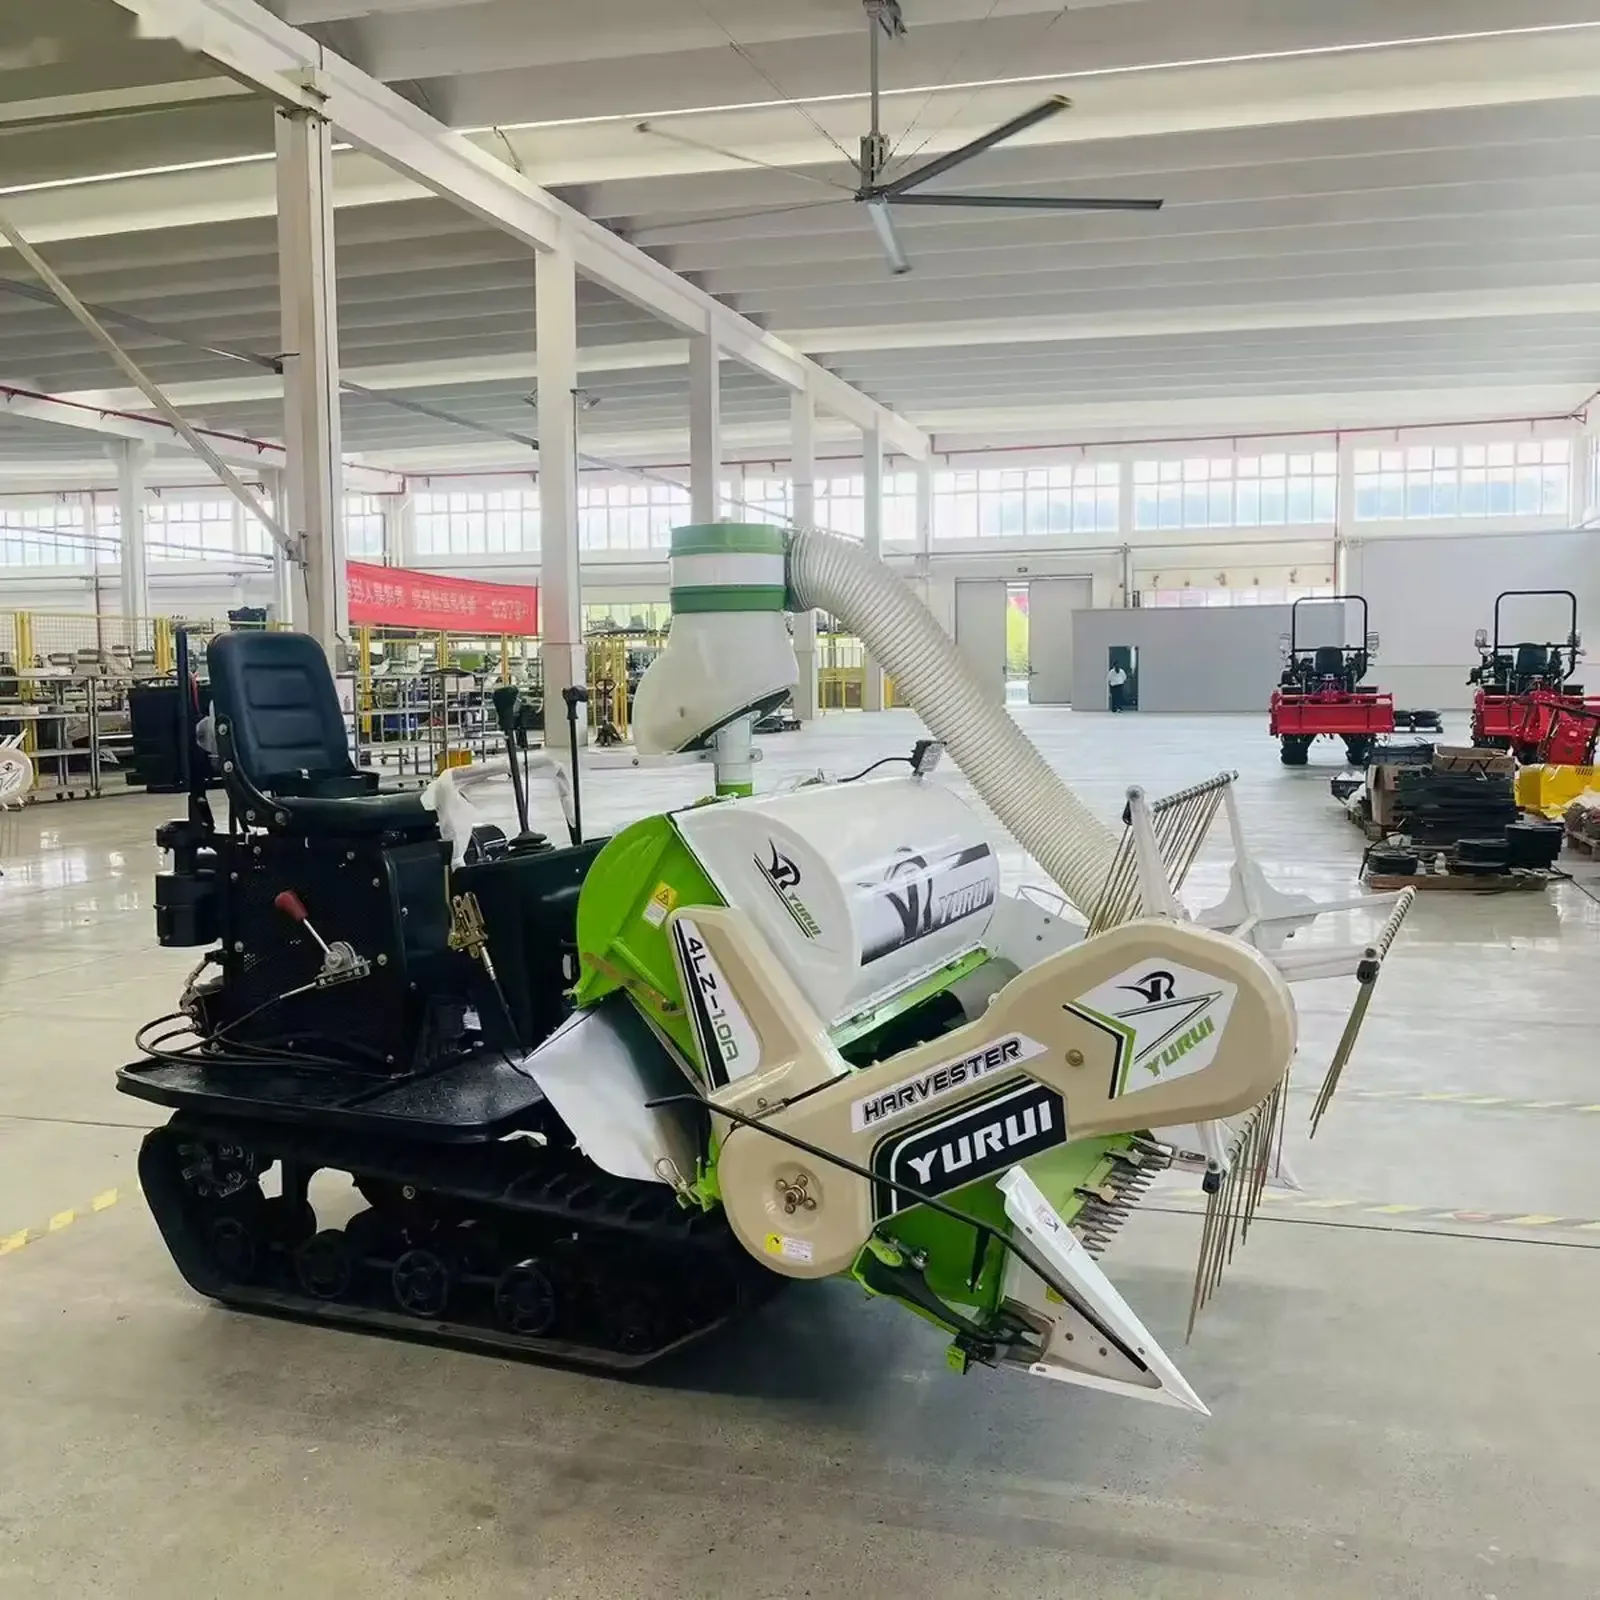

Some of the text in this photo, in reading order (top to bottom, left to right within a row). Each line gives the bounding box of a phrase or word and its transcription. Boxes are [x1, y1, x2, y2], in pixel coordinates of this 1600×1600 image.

[863, 1036, 1023, 1125] HARVESTER
[1143, 1014, 1216, 1078] YURUI
[907, 1100, 1053, 1185] YURUI
